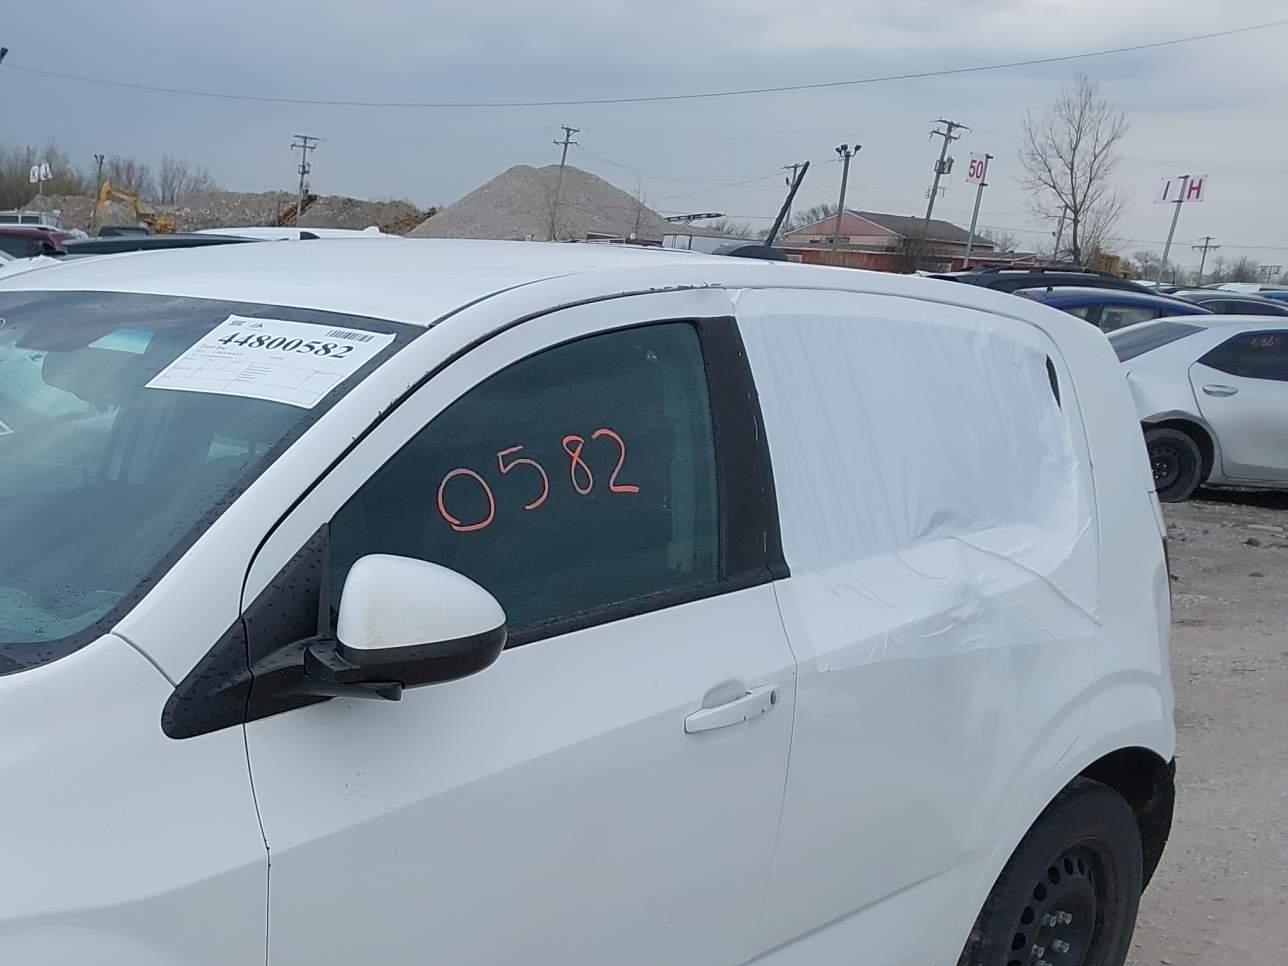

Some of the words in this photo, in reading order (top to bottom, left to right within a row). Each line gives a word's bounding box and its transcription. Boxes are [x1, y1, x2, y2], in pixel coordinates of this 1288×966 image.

[969, 159, 984, 179] 50
[1187, 178, 1203, 200] H
[217, 332, 354, 359] 44800582
[437, 428, 640, 532] 0582
